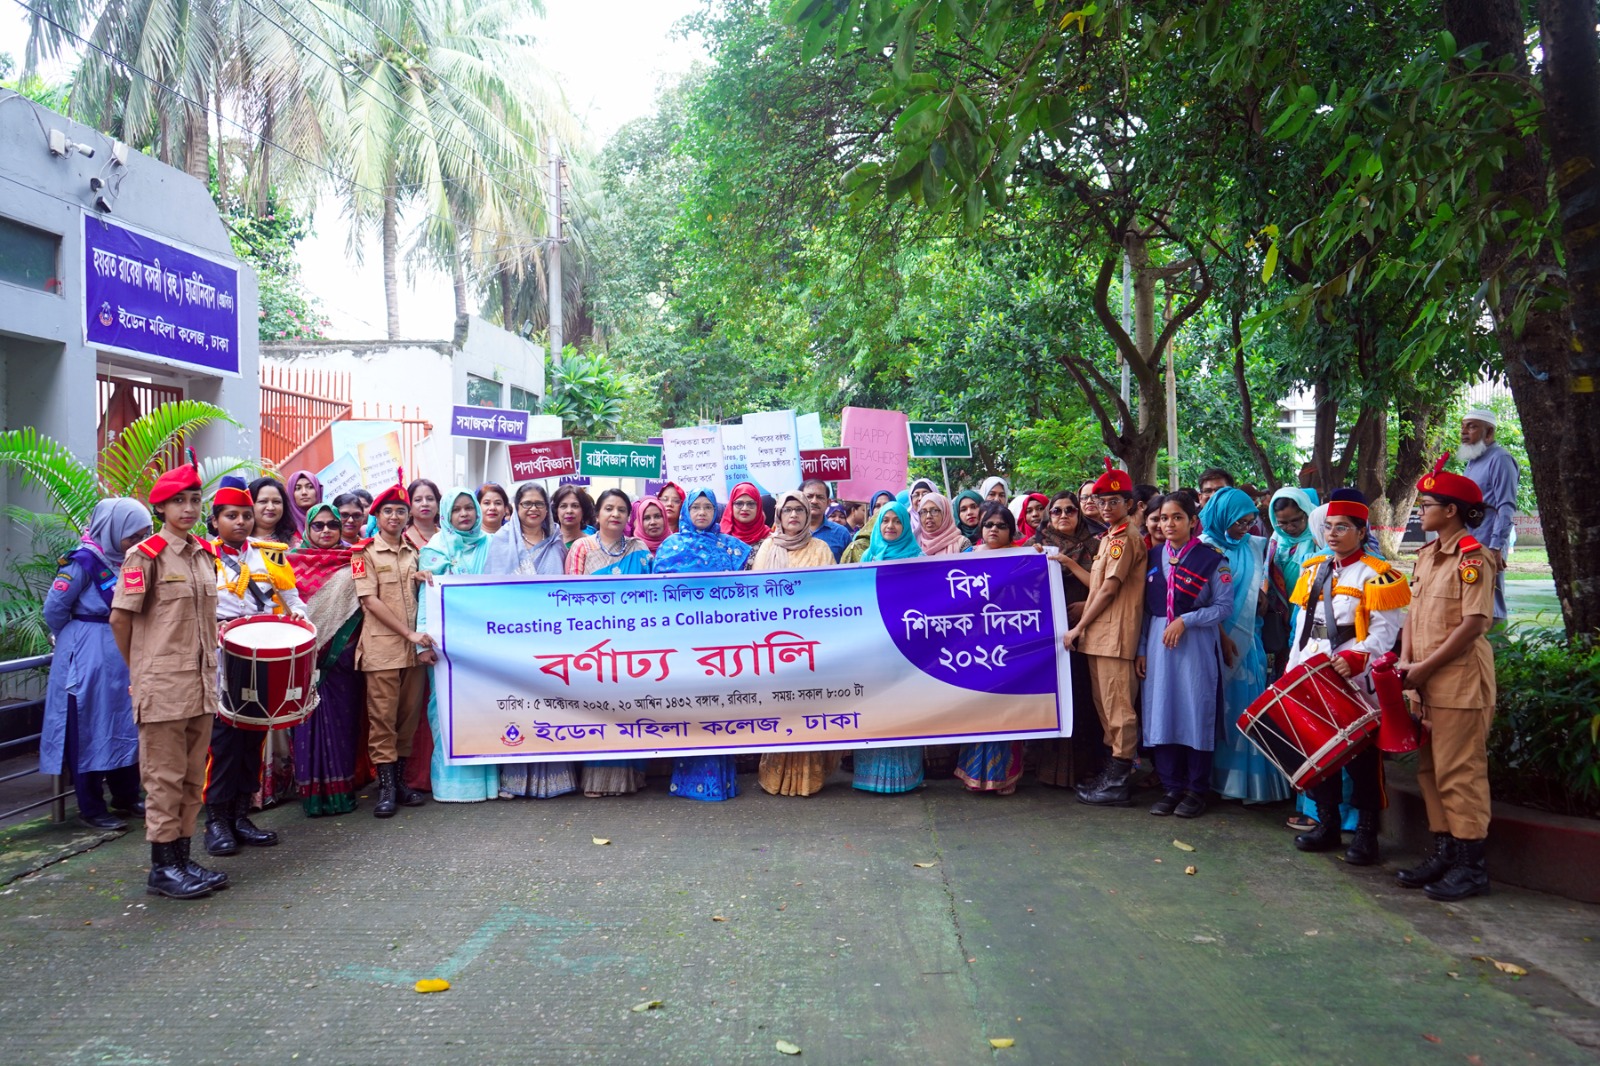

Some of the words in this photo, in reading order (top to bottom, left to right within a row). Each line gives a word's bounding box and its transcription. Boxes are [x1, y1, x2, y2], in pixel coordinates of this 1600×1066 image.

[92, 247, 116, 278] হযরত
[118, 255, 142, 288] রাবেয়া
[184, 272, 216, 309] ছাত্রীনিবাস
[118, 305, 146, 332] ইডেন
[149, 316, 176, 340] মহিলা
[210, 334, 229, 352] ঢাকা
[456, 414, 497, 433] সমাজকর্ম
[498, 416, 524, 435] বিভাগ
[854, 427, 892, 444] HAPPY
[913, 428, 948, 446] সমাজবিজ্ঞান
[948, 428, 966, 446] বিভাগ
[514, 456, 572, 475] পদার্থবিজ্ঞান
[586, 449, 628, 468] রাষ্ট্রবিজ্ঞান
[630, 450, 656, 468] বিভাগ
[820, 454, 847, 472] বিভাগ
[853, 464, 869, 478] AY
[875, 467, 903, 483] 2025
[548, 589, 616, 607] “শিক্ষকতা
[662, 584, 705, 602] মিলিত
[709, 582, 759, 600] প্রচেষ্টার
[764, 579, 801, 597] দীপ্তি”
[946, 569, 991, 601] বিশ্ব
[486, 619, 562, 635] Recasting
[566, 614, 635, 631] Teaching
[641, 617, 657, 627] as
[662, 616, 670, 627] a
[675, 608, 778, 626] Collaborative
[783, 604, 862, 620] Profession
[902, 609, 974, 641] শিক্ষক
[981, 603, 1042, 636] দিবস
[534, 638, 678, 686] বর্ণাঢ্য
[938, 644, 1008, 672] ২০২৫
[496, 695, 524, 711] তারিখ
[534, 699, 540, 710] ৫
[543, 696, 580, 710] অক্টোবর
[619, 700, 632, 710] ২০
[634, 695, 662, 710] আশ্বিন
[666, 697, 692, 708] ১৪৩২
[798, 688, 823, 700] সকাল
[826, 688, 850, 698] ৮:০০
[854, 683, 864, 697] টা
[534, 720, 608, 743] ইডেন
[616, 718, 691, 739] মহিলা
[801, 712, 862, 731] ঢাকা
